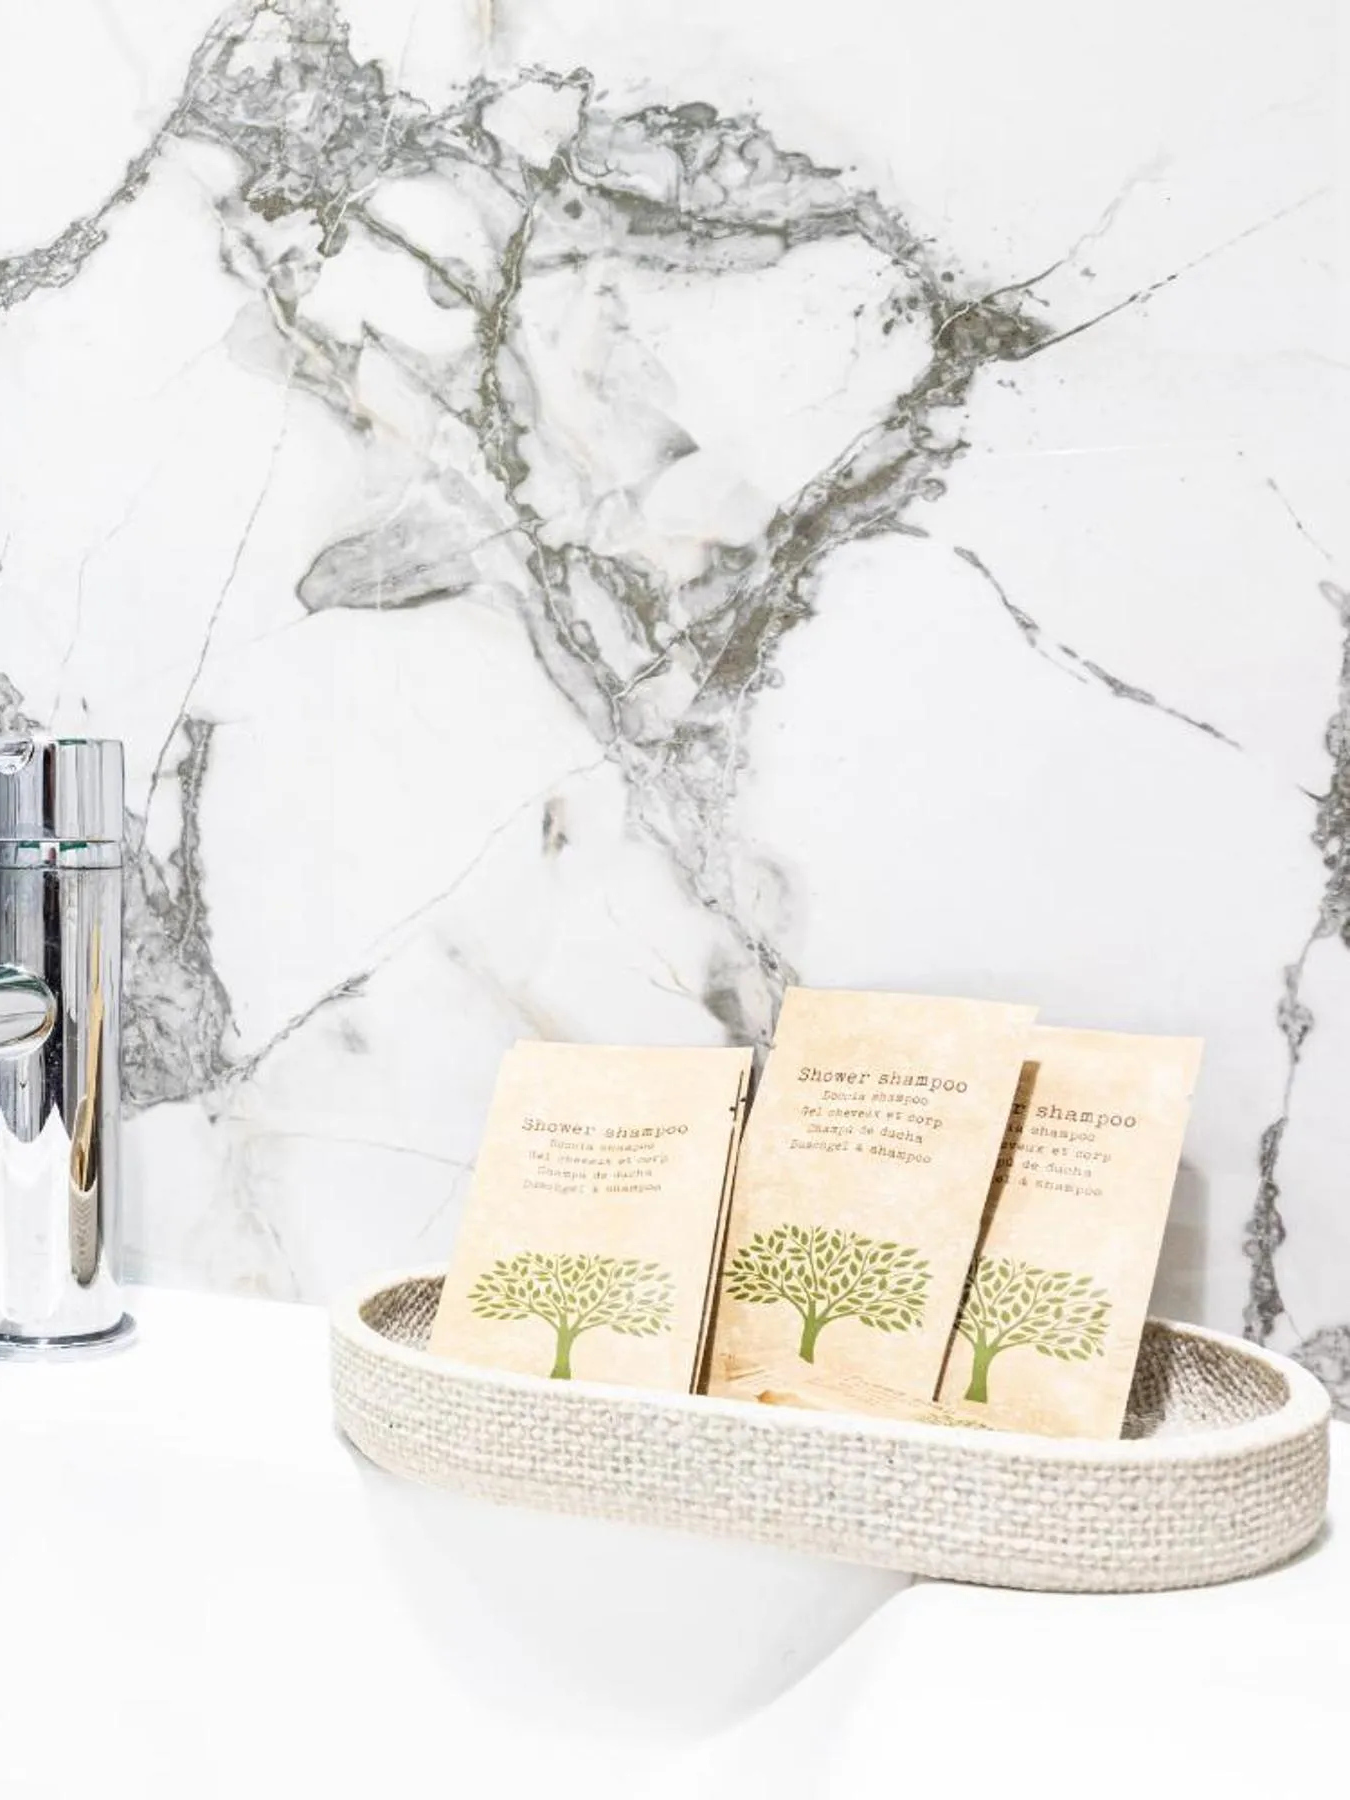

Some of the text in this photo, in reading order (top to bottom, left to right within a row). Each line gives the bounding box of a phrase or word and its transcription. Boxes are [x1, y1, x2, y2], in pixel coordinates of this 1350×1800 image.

[797, 1066, 968, 1094] Shower shampoo
[871, 1090, 929, 1106] shampoo
[907, 1114, 944, 1131] corp
[1035, 1104, 1138, 1129] shampoo
[521, 1116, 689, 1139] Shower shampoo
[880, 1127, 924, 1144] ducha
[1030, 1125, 1097, 1143] shampoo
[869, 1144, 933, 1164] shampoo
[1045, 1162, 1093, 1178] ducha
[1035, 1179, 1104, 1197] shampoo
